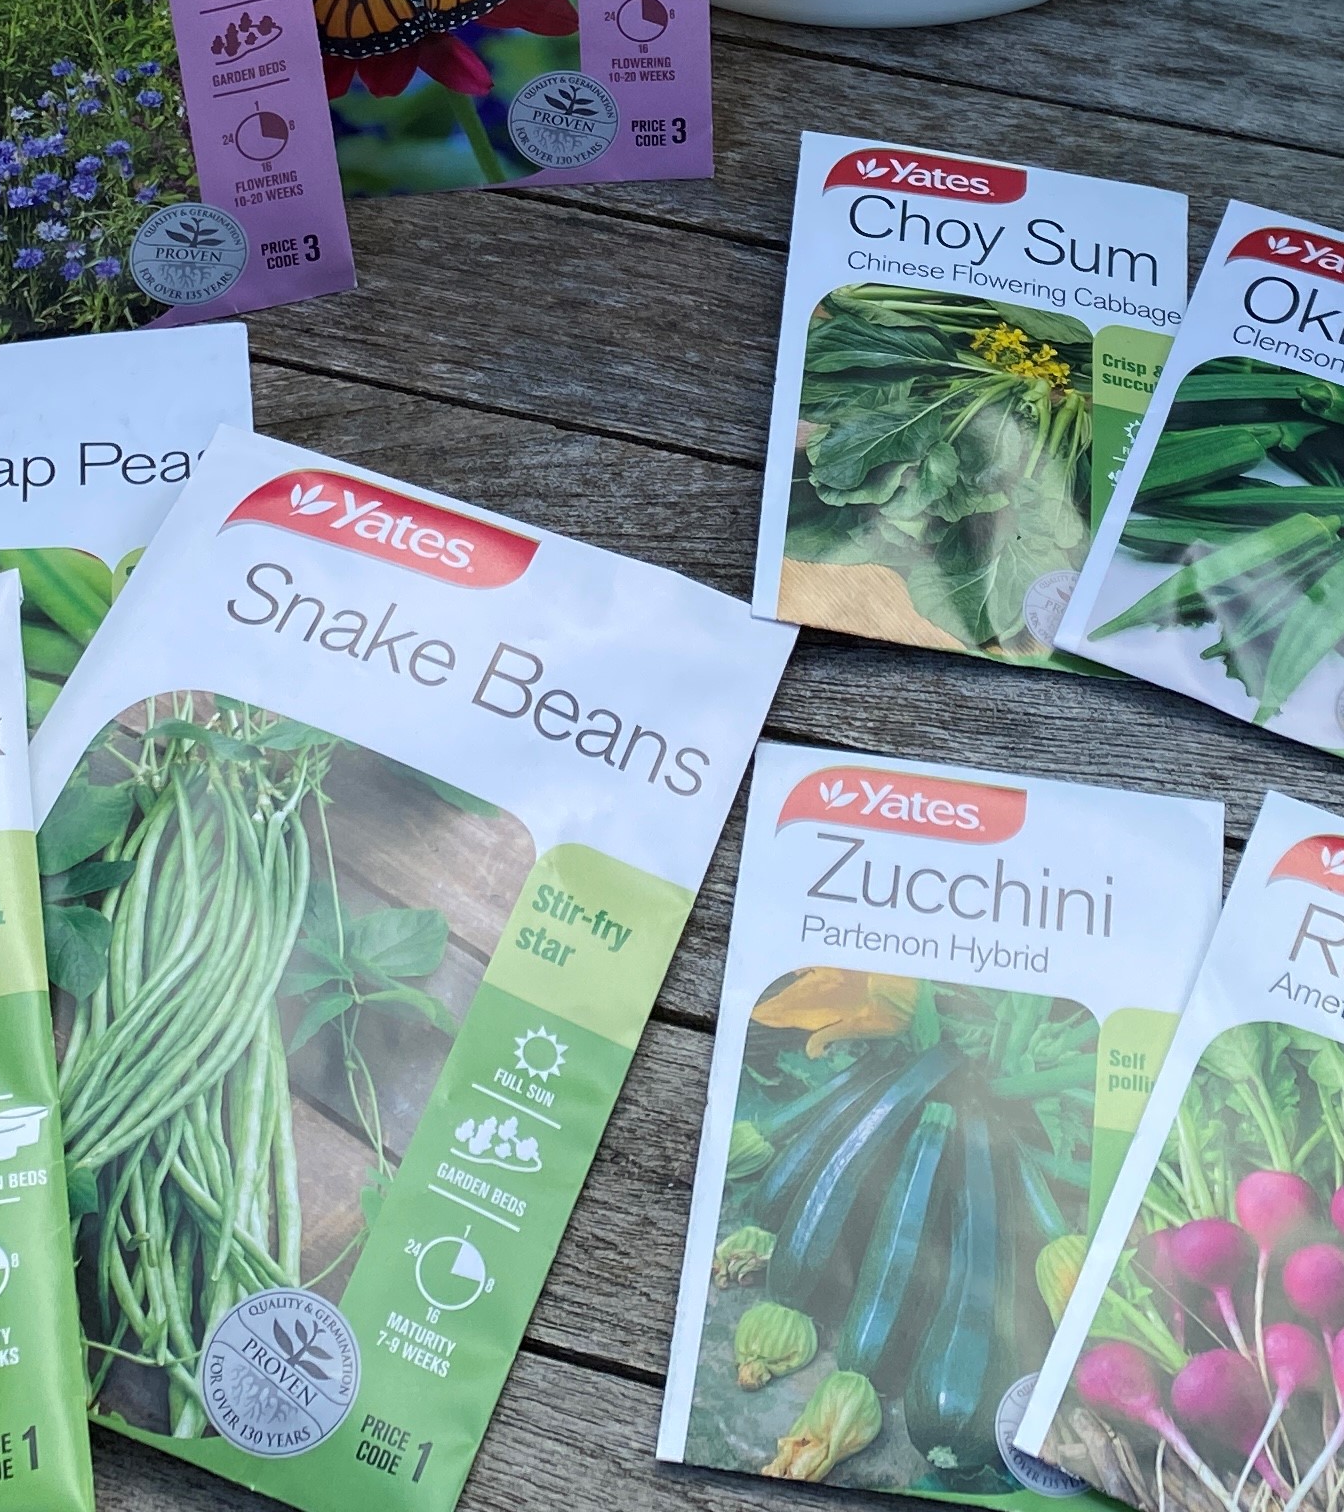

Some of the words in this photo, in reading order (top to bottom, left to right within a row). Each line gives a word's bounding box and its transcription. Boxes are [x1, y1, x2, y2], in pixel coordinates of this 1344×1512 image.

[212, 64, 256, 87] GARDEN
[257, 60, 287, 80] BEDS
[889, 159, 990, 197] Yates
[260, 237, 298, 256] PRICE
[266, 251, 301, 271] CODE
[303, 233, 321, 264] 3
[848, 194, 1006, 266] Choy
[1023, 218, 1158, 287] Sum
[847, 250, 945, 280] Chinese
[952, 264, 1067, 307] Flowering
[1074, 288, 1182, 327] Cabbage
[1102, 353, 1147, 377] Crisp
[330, 490, 475, 573] Yates
[227, 561, 457, 688] Snake
[472, 641, 711, 798] Beans
[859, 780, 980, 831] Yates
[806, 832, 1114, 938] Zucchini
[531, 882, 632, 952] Stir-fry
[514, 927, 577, 970] star
[800, 914, 939, 960] Partenon
[949, 933, 1050, 974] Hybrid
[1109, 1049, 1147, 1070] Self
[360, 1414, 409, 1452] PRICE
[355, 1440, 402, 1478] CODE
[413, 1440, 435, 1484] 1
